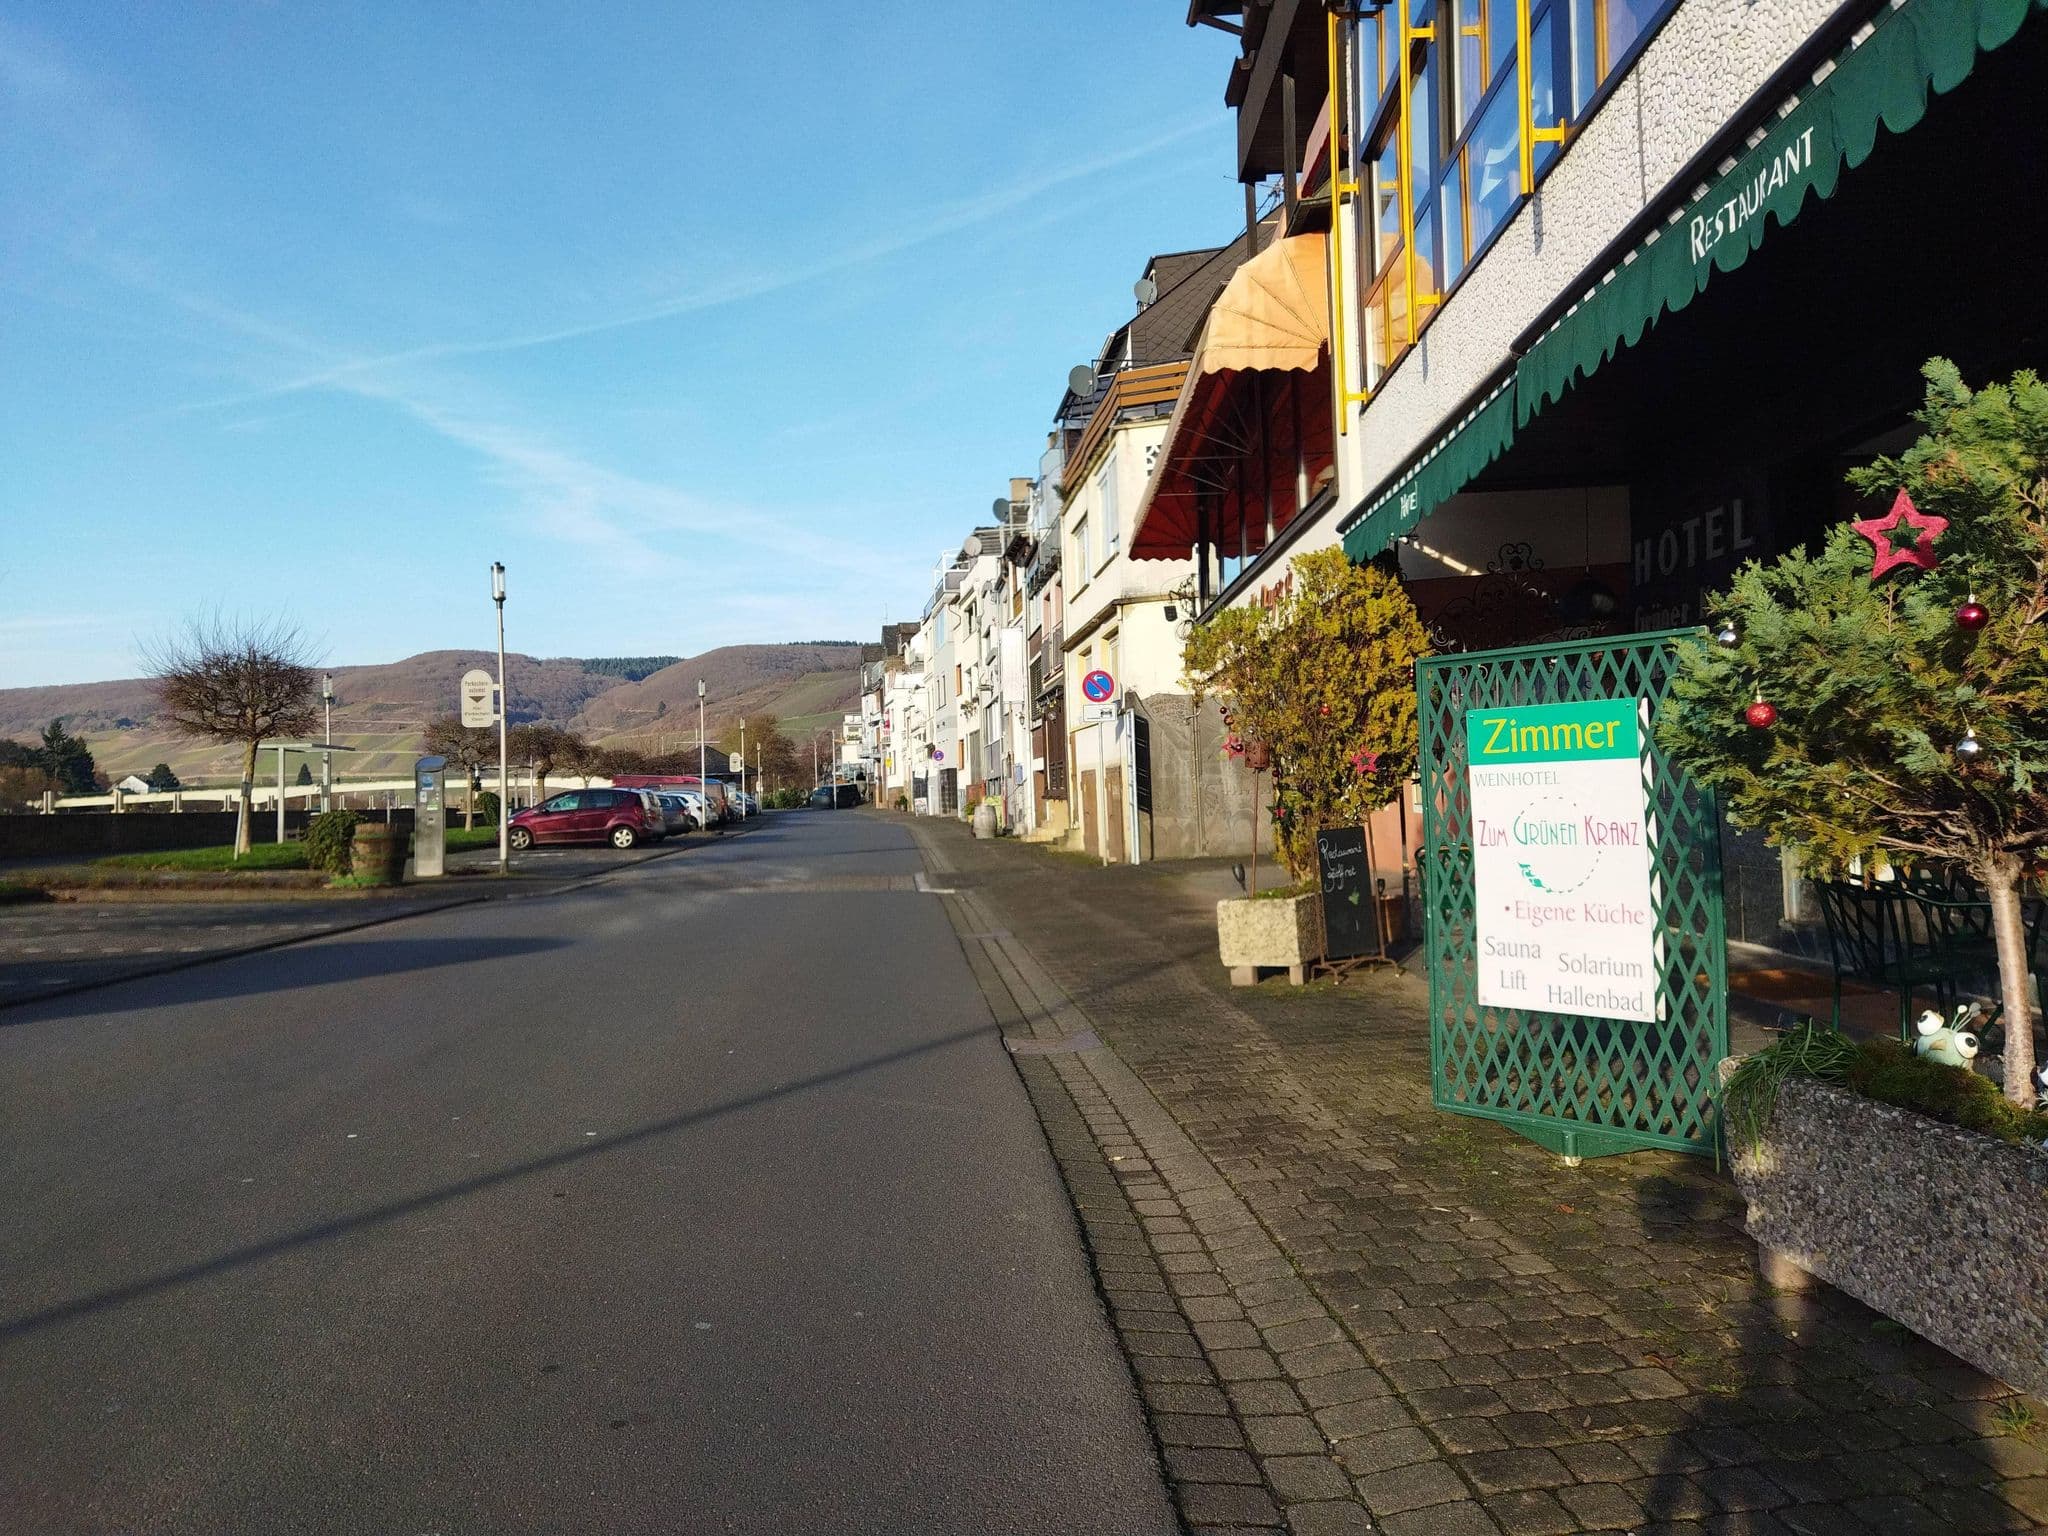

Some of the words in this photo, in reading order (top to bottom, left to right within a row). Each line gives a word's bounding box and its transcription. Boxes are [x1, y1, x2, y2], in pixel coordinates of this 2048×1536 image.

[1690, 126, 1814, 265] RESTAURANT
[1634, 499, 1755, 586] HOTEL
[1482, 718, 1621, 754] Zimmer
[1474, 771, 1560, 788] WEINHOTEL
[1478, 819, 1509, 847] ZUM
[1513, 816, 1578, 847] GRÜNEN
[1585, 814, 1640, 847] KRANZ
[1515, 900, 1576, 928] Eigene
[1584, 902, 1645, 926] Küche
[1484, 936, 1542, 960] Sauna
[1558, 952, 1644, 978] Solarium
[1500, 969, 1528, 991] Lift
[1547, 984, 1645, 1013] Hallenbad
